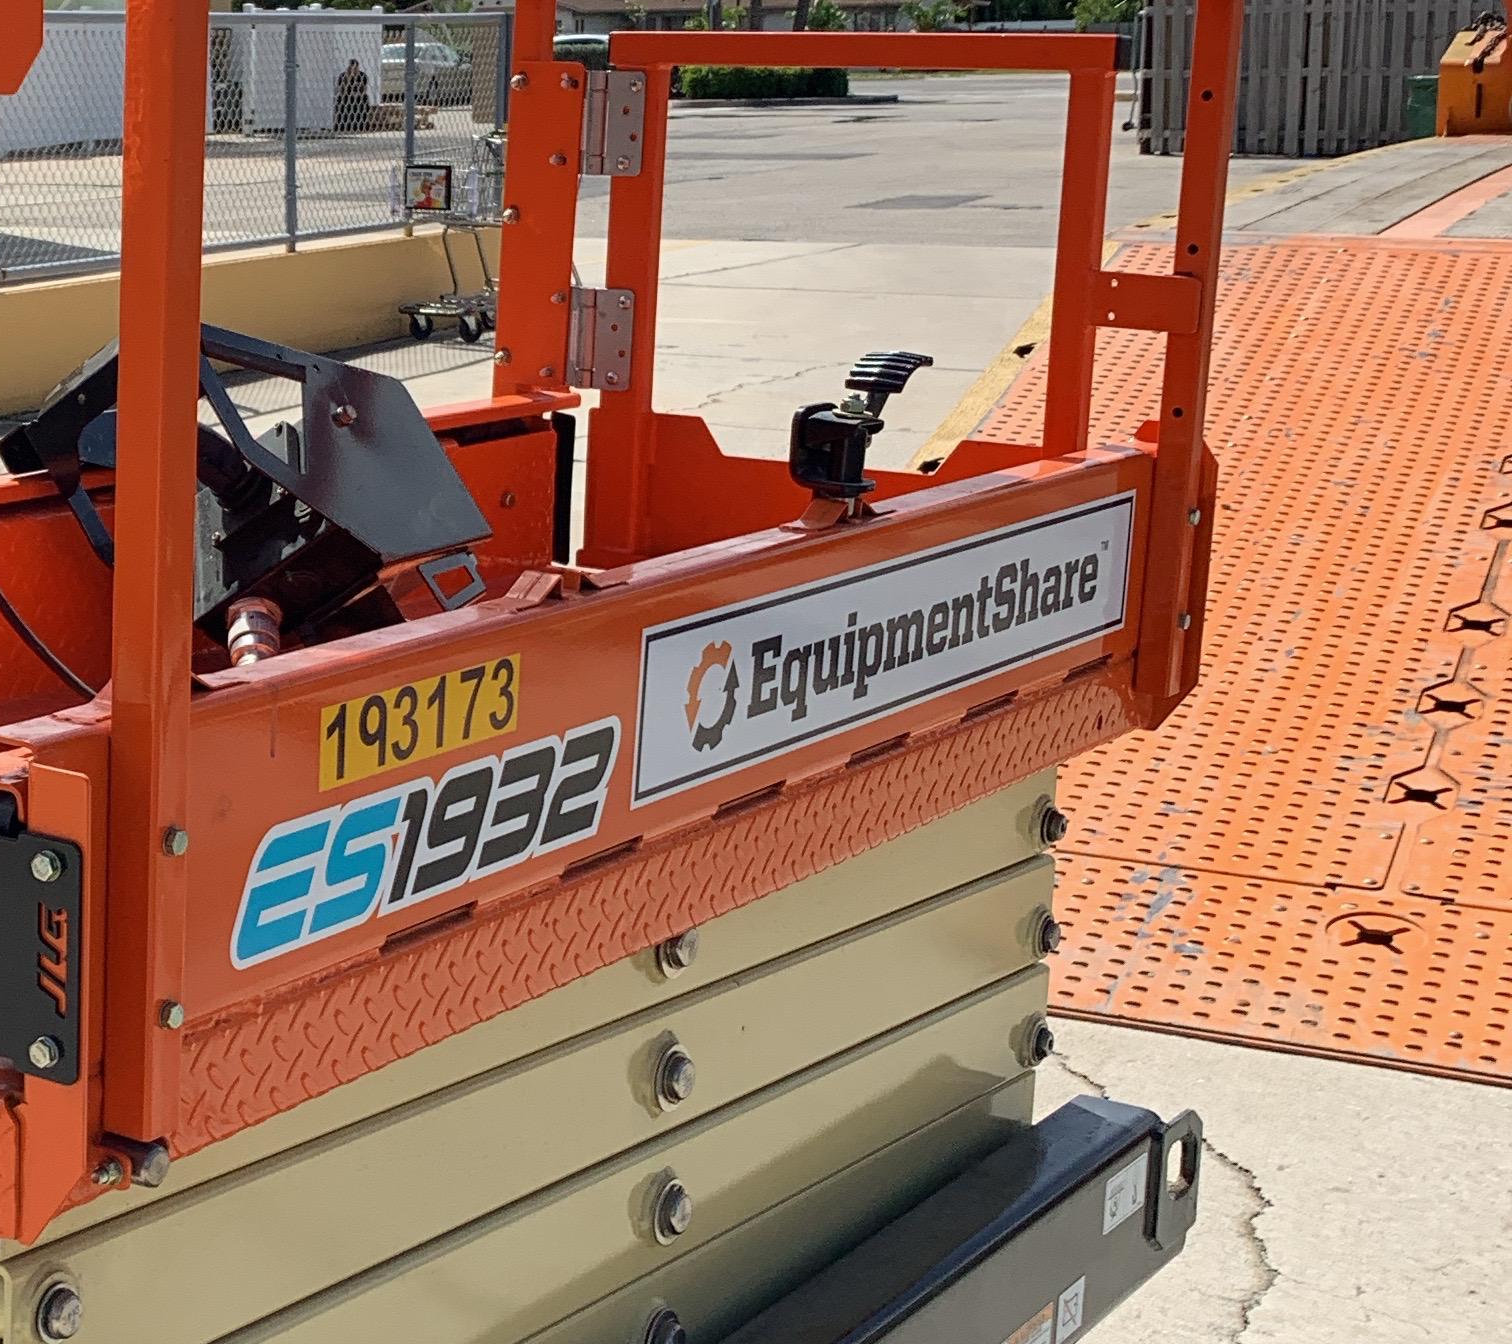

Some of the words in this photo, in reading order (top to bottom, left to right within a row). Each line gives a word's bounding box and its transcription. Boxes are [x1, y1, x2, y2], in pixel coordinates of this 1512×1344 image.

[746, 553, 1099, 722] EquipmentShare
[326, 658, 515, 780] 193173
[235, 725, 616, 962] ES1932
[38, 902, 68, 1019] JLG
